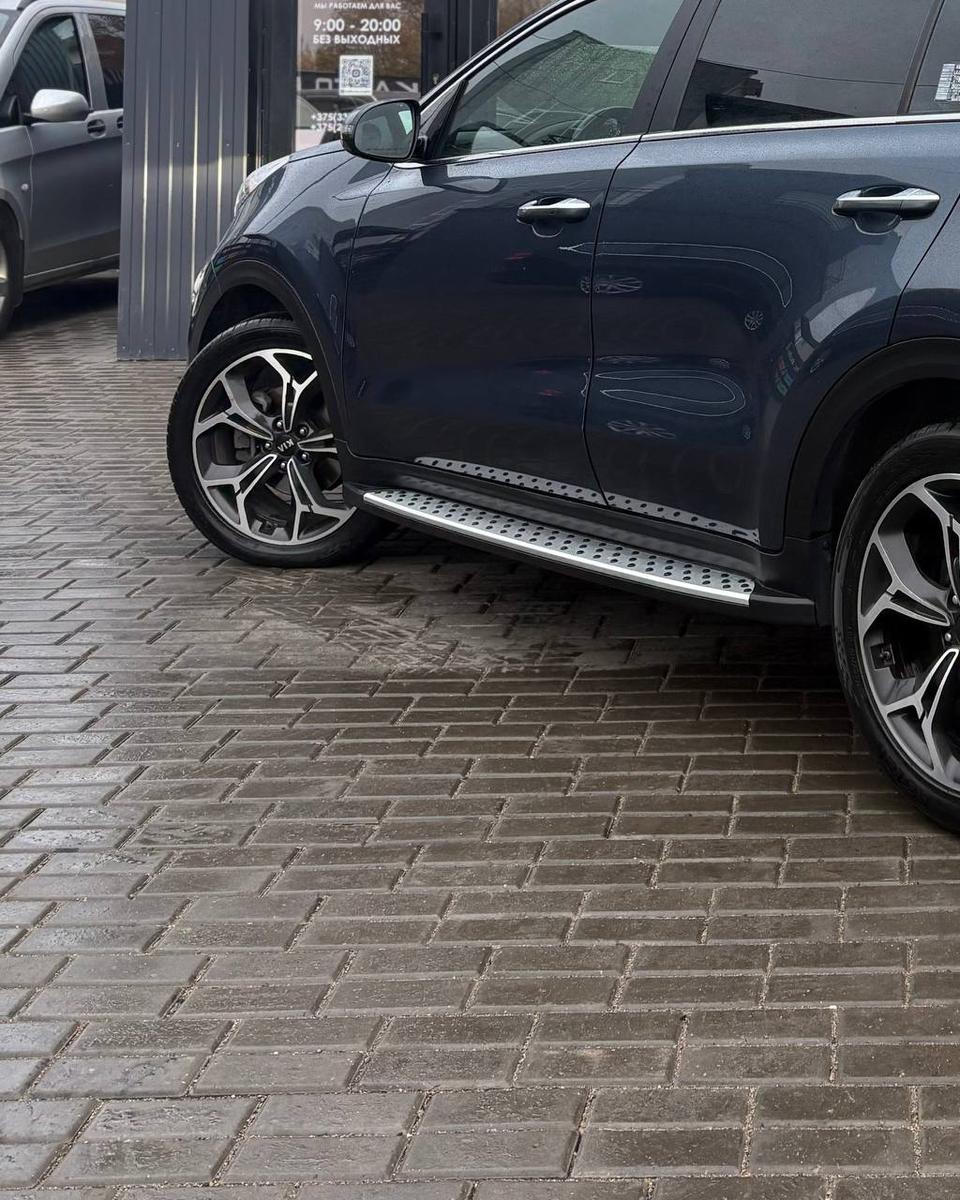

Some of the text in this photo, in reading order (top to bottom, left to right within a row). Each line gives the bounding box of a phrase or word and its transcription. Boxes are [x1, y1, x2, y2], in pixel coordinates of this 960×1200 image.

[369, 2, 384, 10] ДЛЯ
[313, 18, 345, 32] 9:00
[360, 18, 401, 32] 20:00
[313, 34, 401, 45] БЕЗ ВЫХОДНЫХ
[277, 438, 294, 452] KIA
